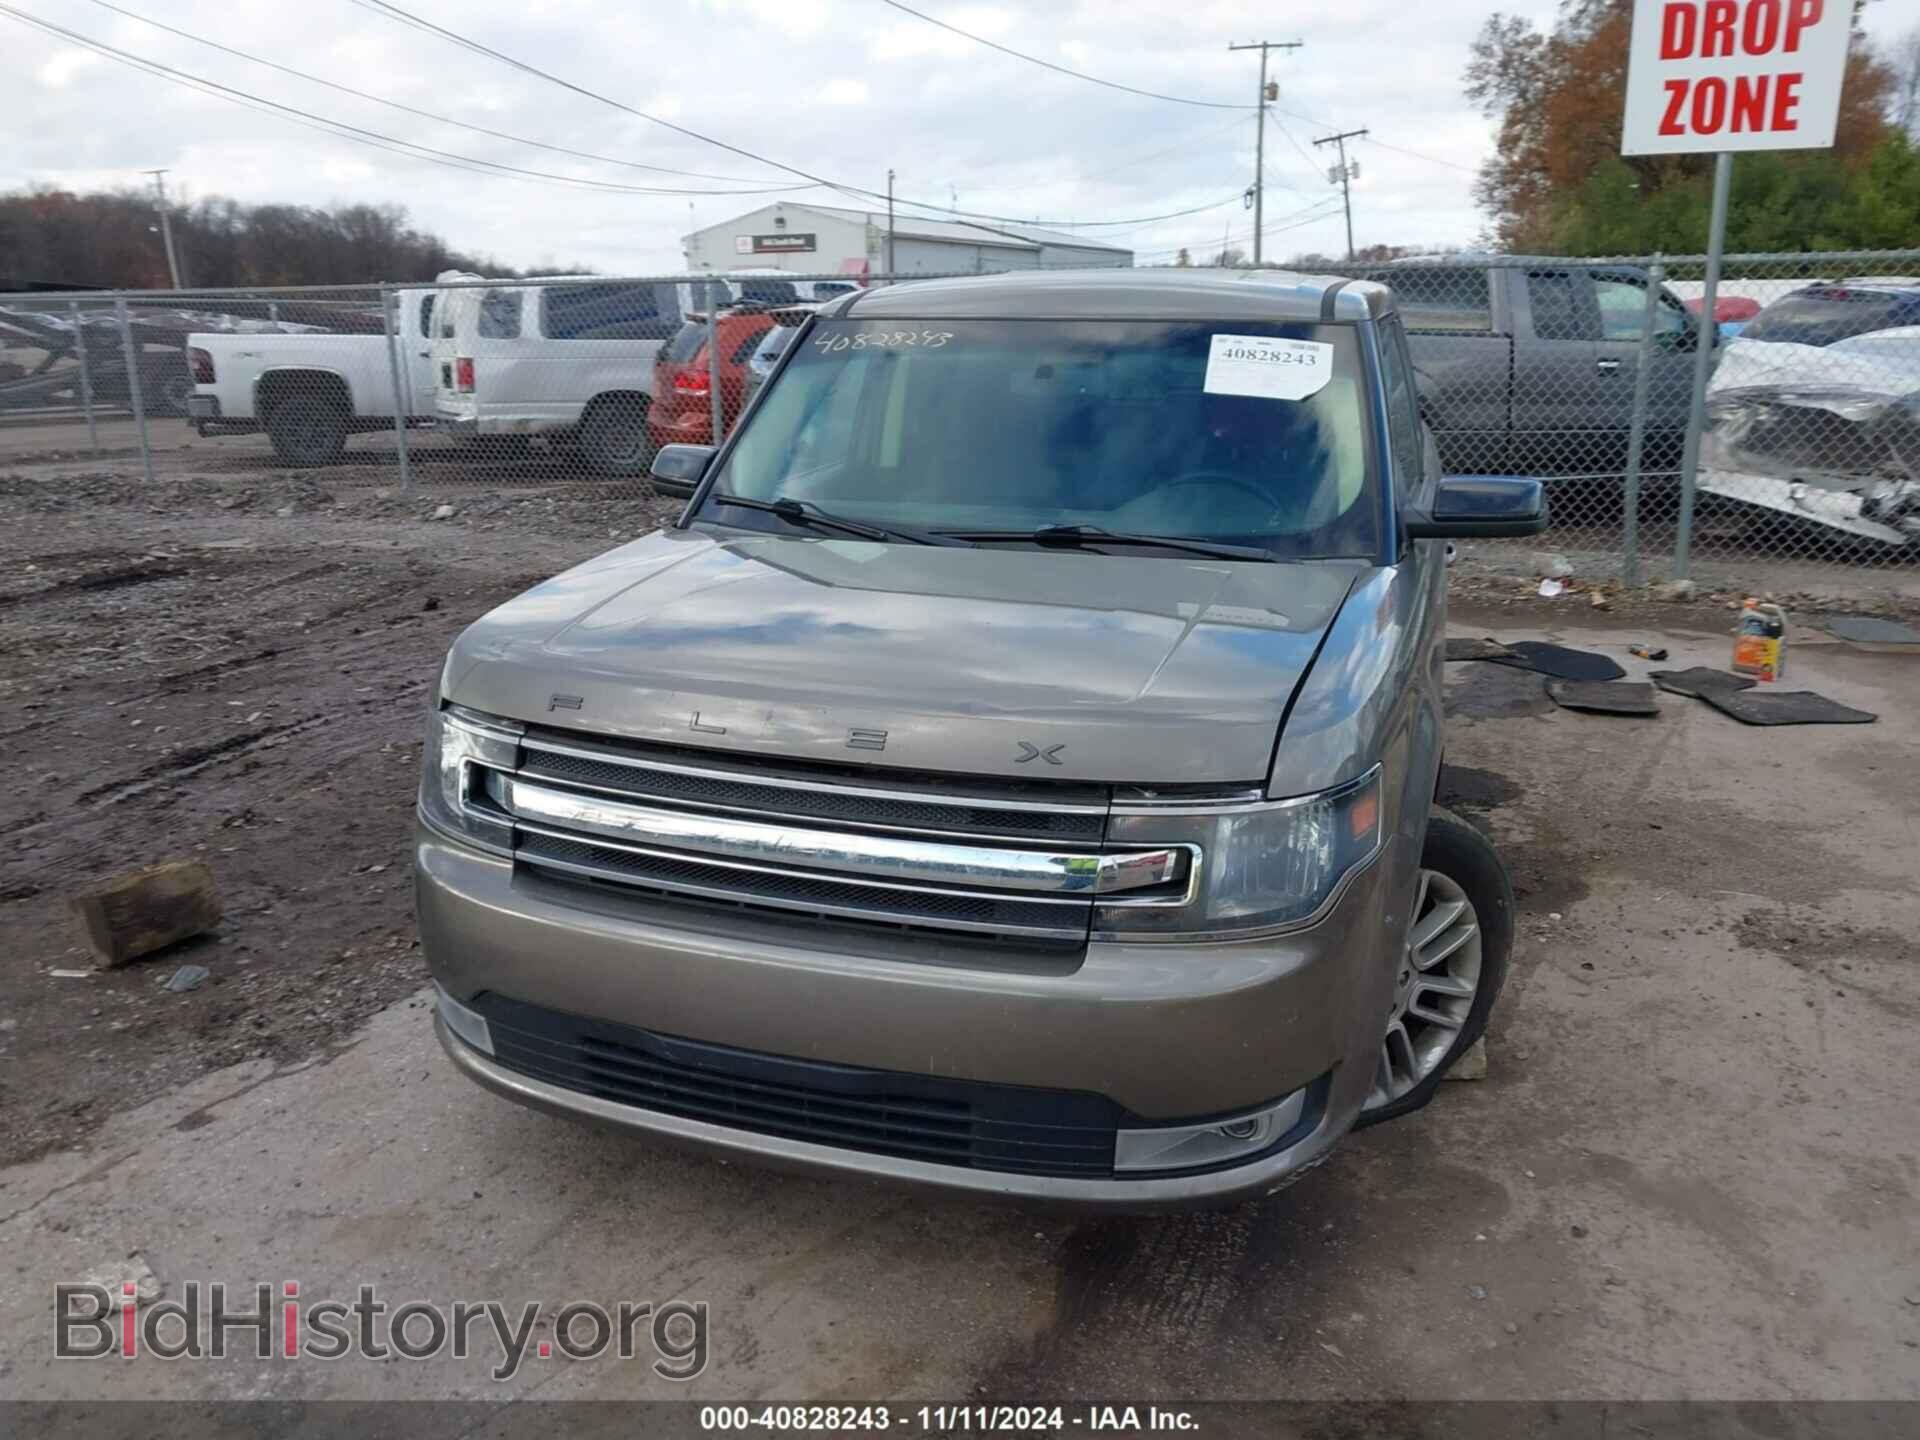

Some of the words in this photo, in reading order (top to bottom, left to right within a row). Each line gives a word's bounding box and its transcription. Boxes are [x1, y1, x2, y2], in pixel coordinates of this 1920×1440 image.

[1659, 0, 1824, 60] DROP
[1658, 73, 1803, 136] ZONE
[1222, 348, 1317, 366] 40828243
[549, 692, 1066, 766] FLEX
